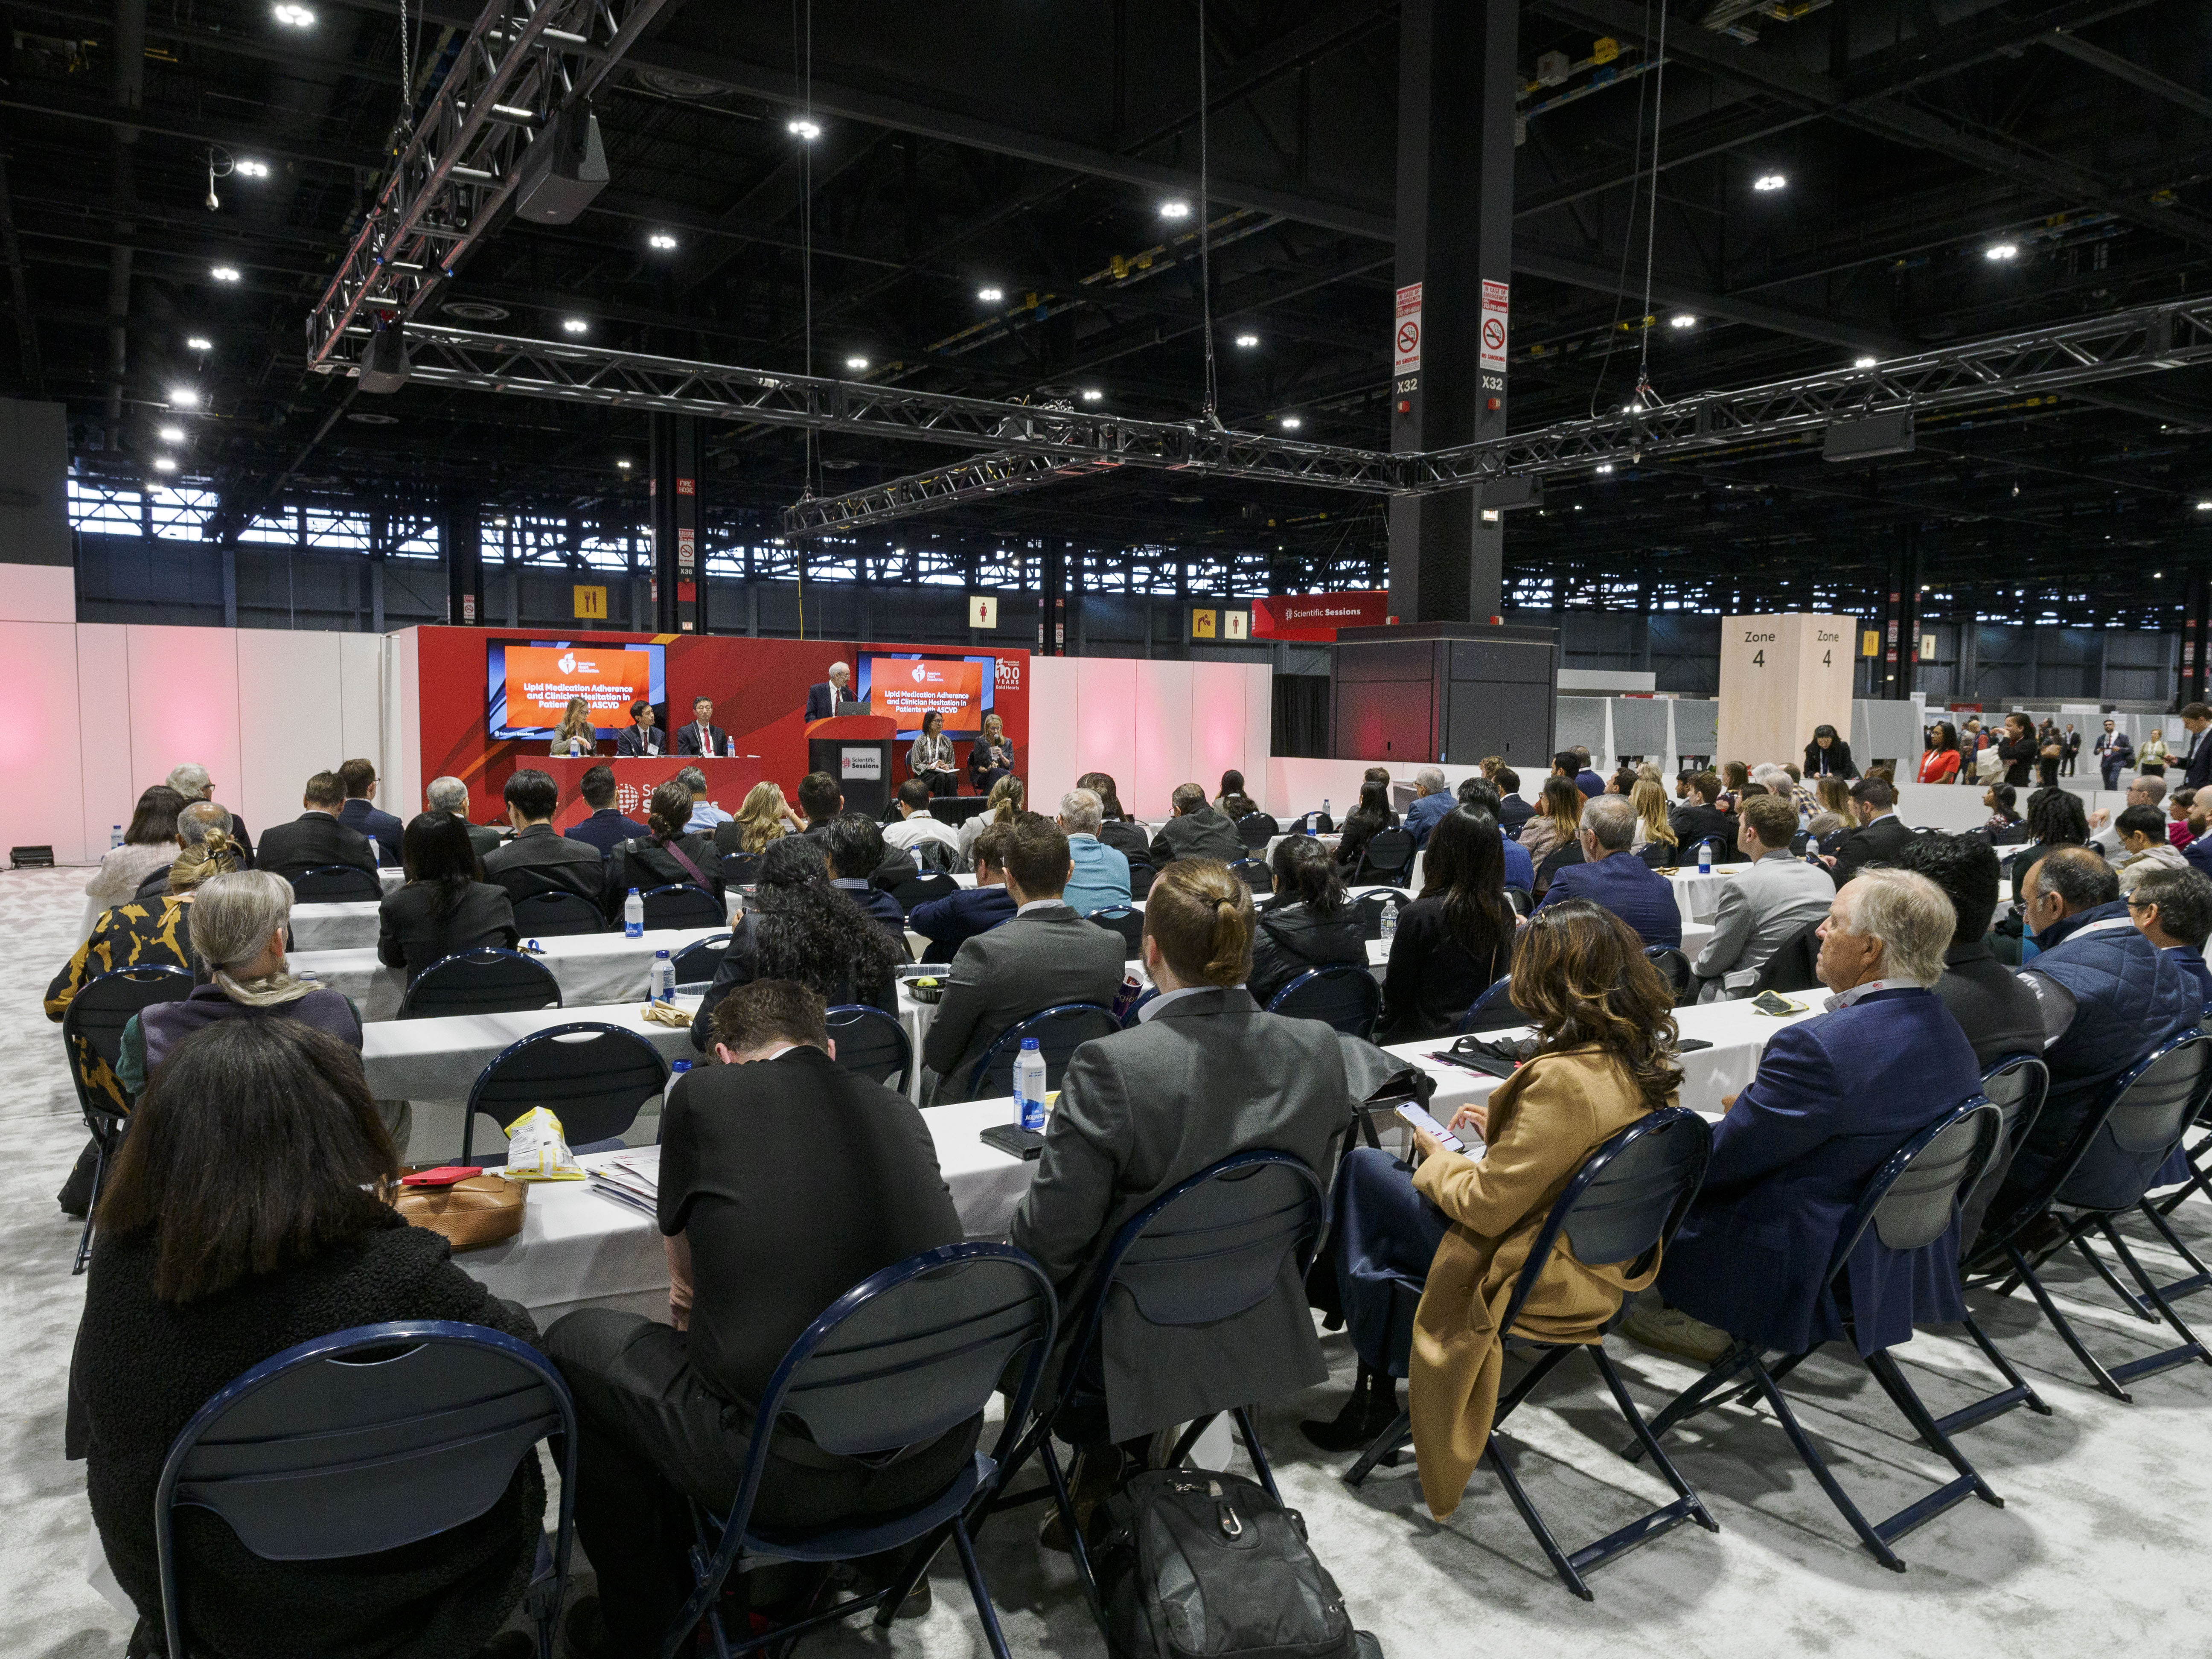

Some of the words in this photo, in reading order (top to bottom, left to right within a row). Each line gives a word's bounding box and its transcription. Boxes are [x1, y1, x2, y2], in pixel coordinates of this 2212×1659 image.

[1397, 295, 1420, 306] EMERGENCY
[1483, 292, 1507, 301] EMERGENCY
[1402, 355, 1419, 364] SMOKING
[1487, 354, 1505, 362] SMOKING
[1397, 378, 1417, 394] X32
[1482, 375, 1503, 391] X32
[1294, 608, 1323, 617] Scientific
[1325, 608, 1360, 616] Sessions
[1745, 632, 1775, 642] Zone
[1818, 630, 1839, 642] Zone
[1752, 649, 1765, 667] 4
[1823, 649, 1831, 667] 4
[524, 683, 544, 692] Lipid
[545, 683, 590, 692] Medication
[591, 684, 633, 693] Adherence
[581, 693, 621, 701] Hesitation
[885, 690, 900, 698] Lipid
[538, 700, 568, 708] Patient
